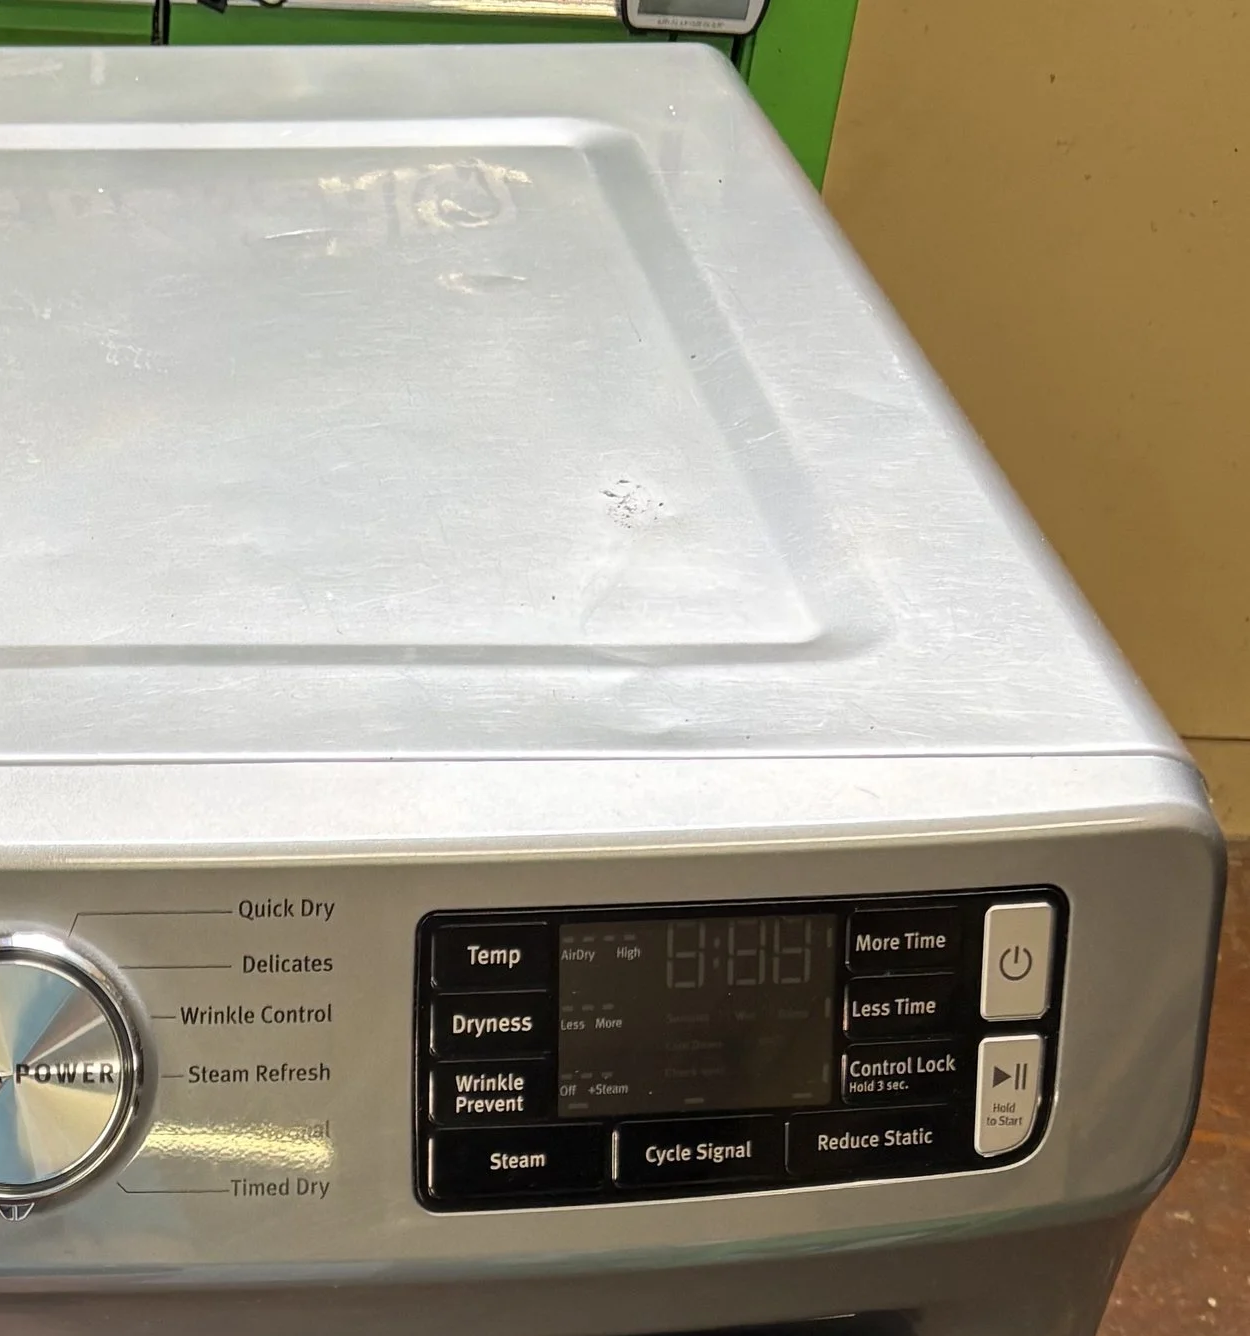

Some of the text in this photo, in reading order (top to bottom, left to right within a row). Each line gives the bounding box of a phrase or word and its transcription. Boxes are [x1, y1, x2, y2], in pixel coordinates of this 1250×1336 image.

[238, 899, 335, 921] Quick Dry
[855, 932, 946, 952] More Time
[467, 945, 521, 968] Temp
[616, 946, 641, 960] High
[242, 955, 333, 974] Delicates
[180, 1004, 333, 1025] Wrinkle Control
[852, 999, 936, 1018] Less Time
[452, 1014, 533, 1038] Dryness
[560, 1018, 622, 1031] Less More
[15, 1063, 114, 1084] POWER
[188, 1063, 331, 1083] Steam Refresh
[850, 1054, 956, 1077] Control Lock
[455, 1073, 524, 1092] Wrinkle
[560, 1084, 577, 1096] Off
[850, 1081, 909, 1093] Hold 3 sec.
[455, 1095, 524, 1113] Prevent
[993, 1103, 1015, 1113] Hold
[986, 1115, 1022, 1126] to Start
[818, 1128, 933, 1151] Reduce Static
[489, 1153, 546, 1170] Steam
[645, 1140, 752, 1166] Cycle Signal
[230, 1178, 330, 1199] Timed Dry
